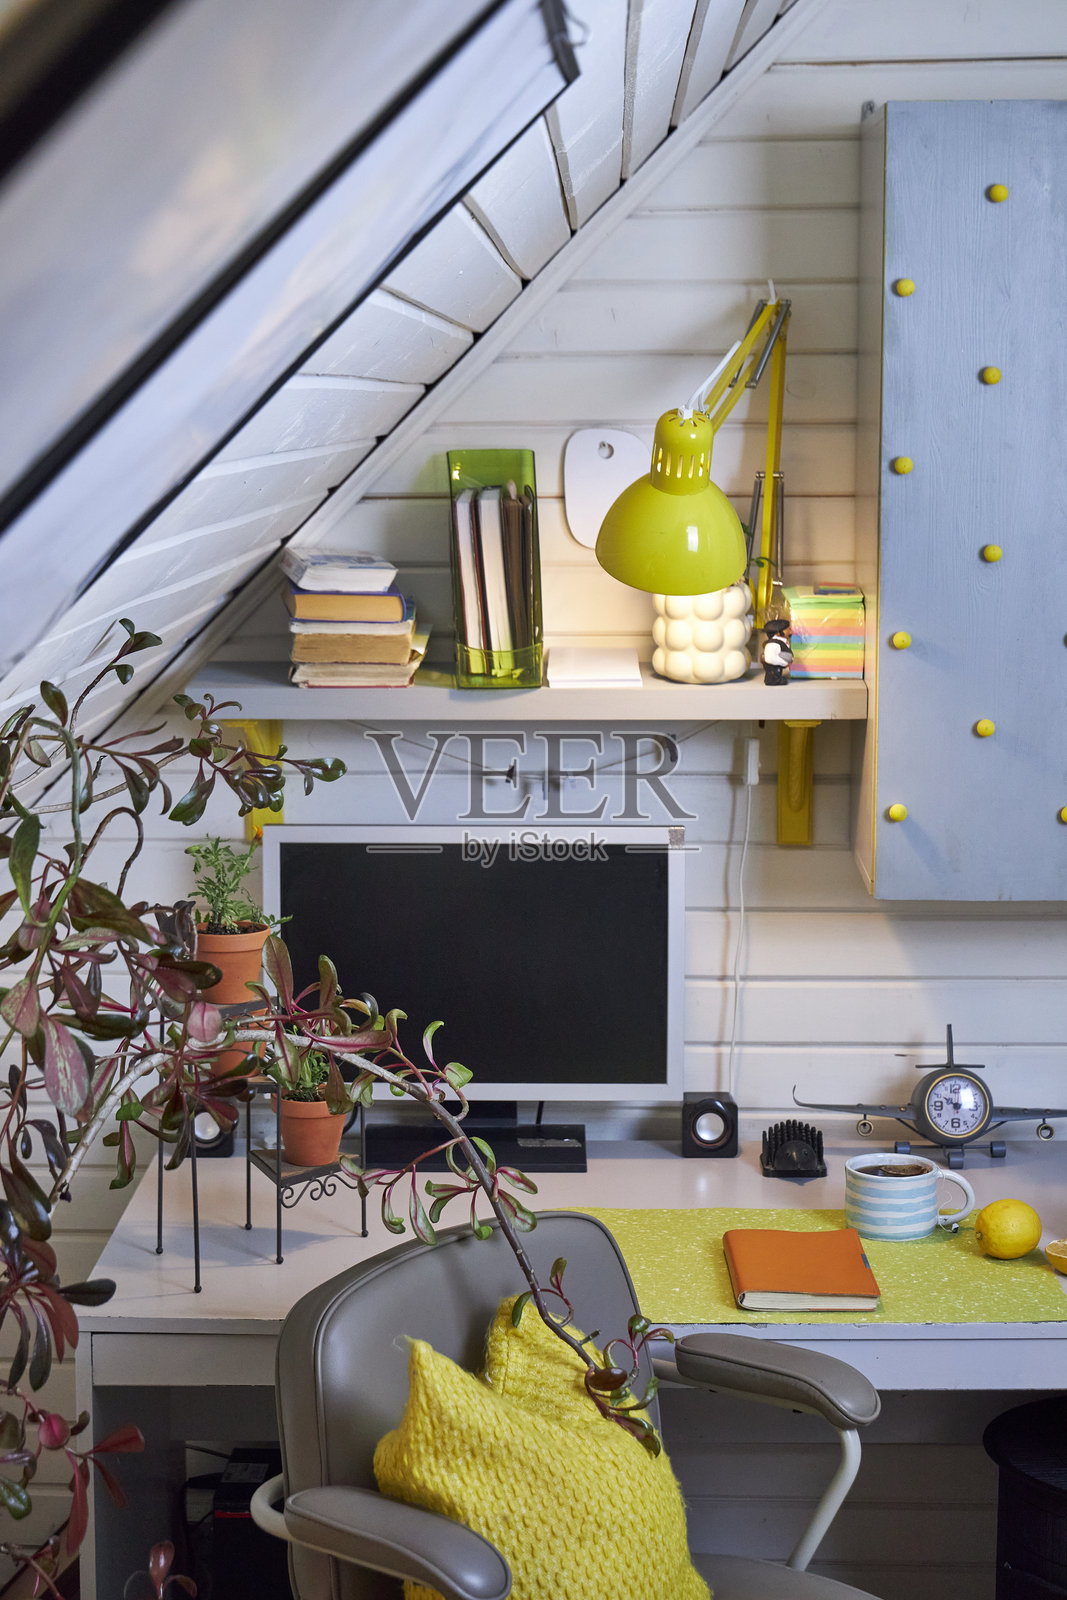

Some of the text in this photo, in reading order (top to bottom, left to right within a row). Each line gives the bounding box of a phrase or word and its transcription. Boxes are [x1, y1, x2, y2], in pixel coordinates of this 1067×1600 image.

[950, 1084, 961, 1094] 12
[934, 1101, 943, 1111] 9
[951, 1118, 960, 1128] 6
